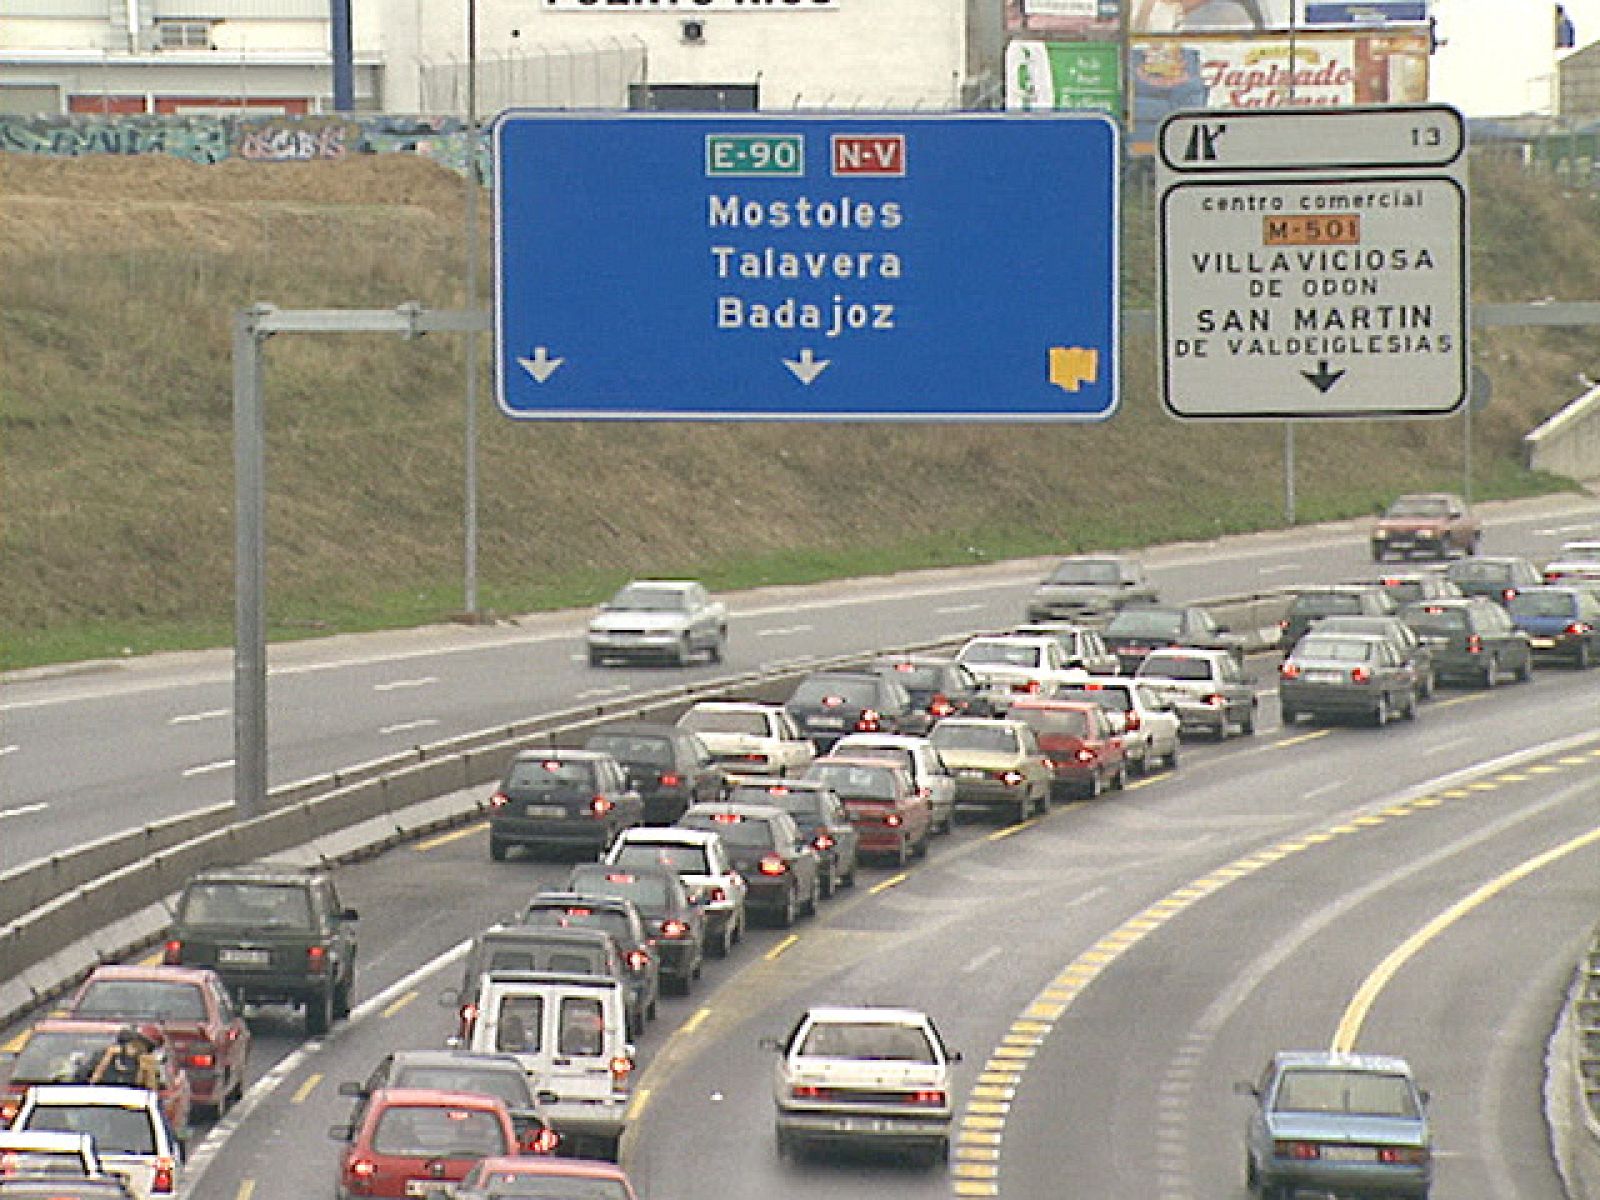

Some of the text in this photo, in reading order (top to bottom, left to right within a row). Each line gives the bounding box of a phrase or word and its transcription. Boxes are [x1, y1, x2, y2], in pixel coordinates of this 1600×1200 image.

[1412, 127, 1442, 146] 13
[713, 142, 796, 169] E-90
[838, 142, 896, 169] N-V
[709, 195, 902, 228] Mostoles
[1202, 189, 1424, 211] centro comercial
[1269, 219, 1356, 240] M-501
[710, 246, 901, 278] Talavera
[1192, 249, 1434, 273] VILLAVICIOSA
[1249, 277, 1378, 298] DE ODON
[718, 294, 895, 337] Badajoz
[1197, 305, 1431, 332] SAN MARTIN
[1175, 335, 1452, 357] DE VALDEIGLESIAS
